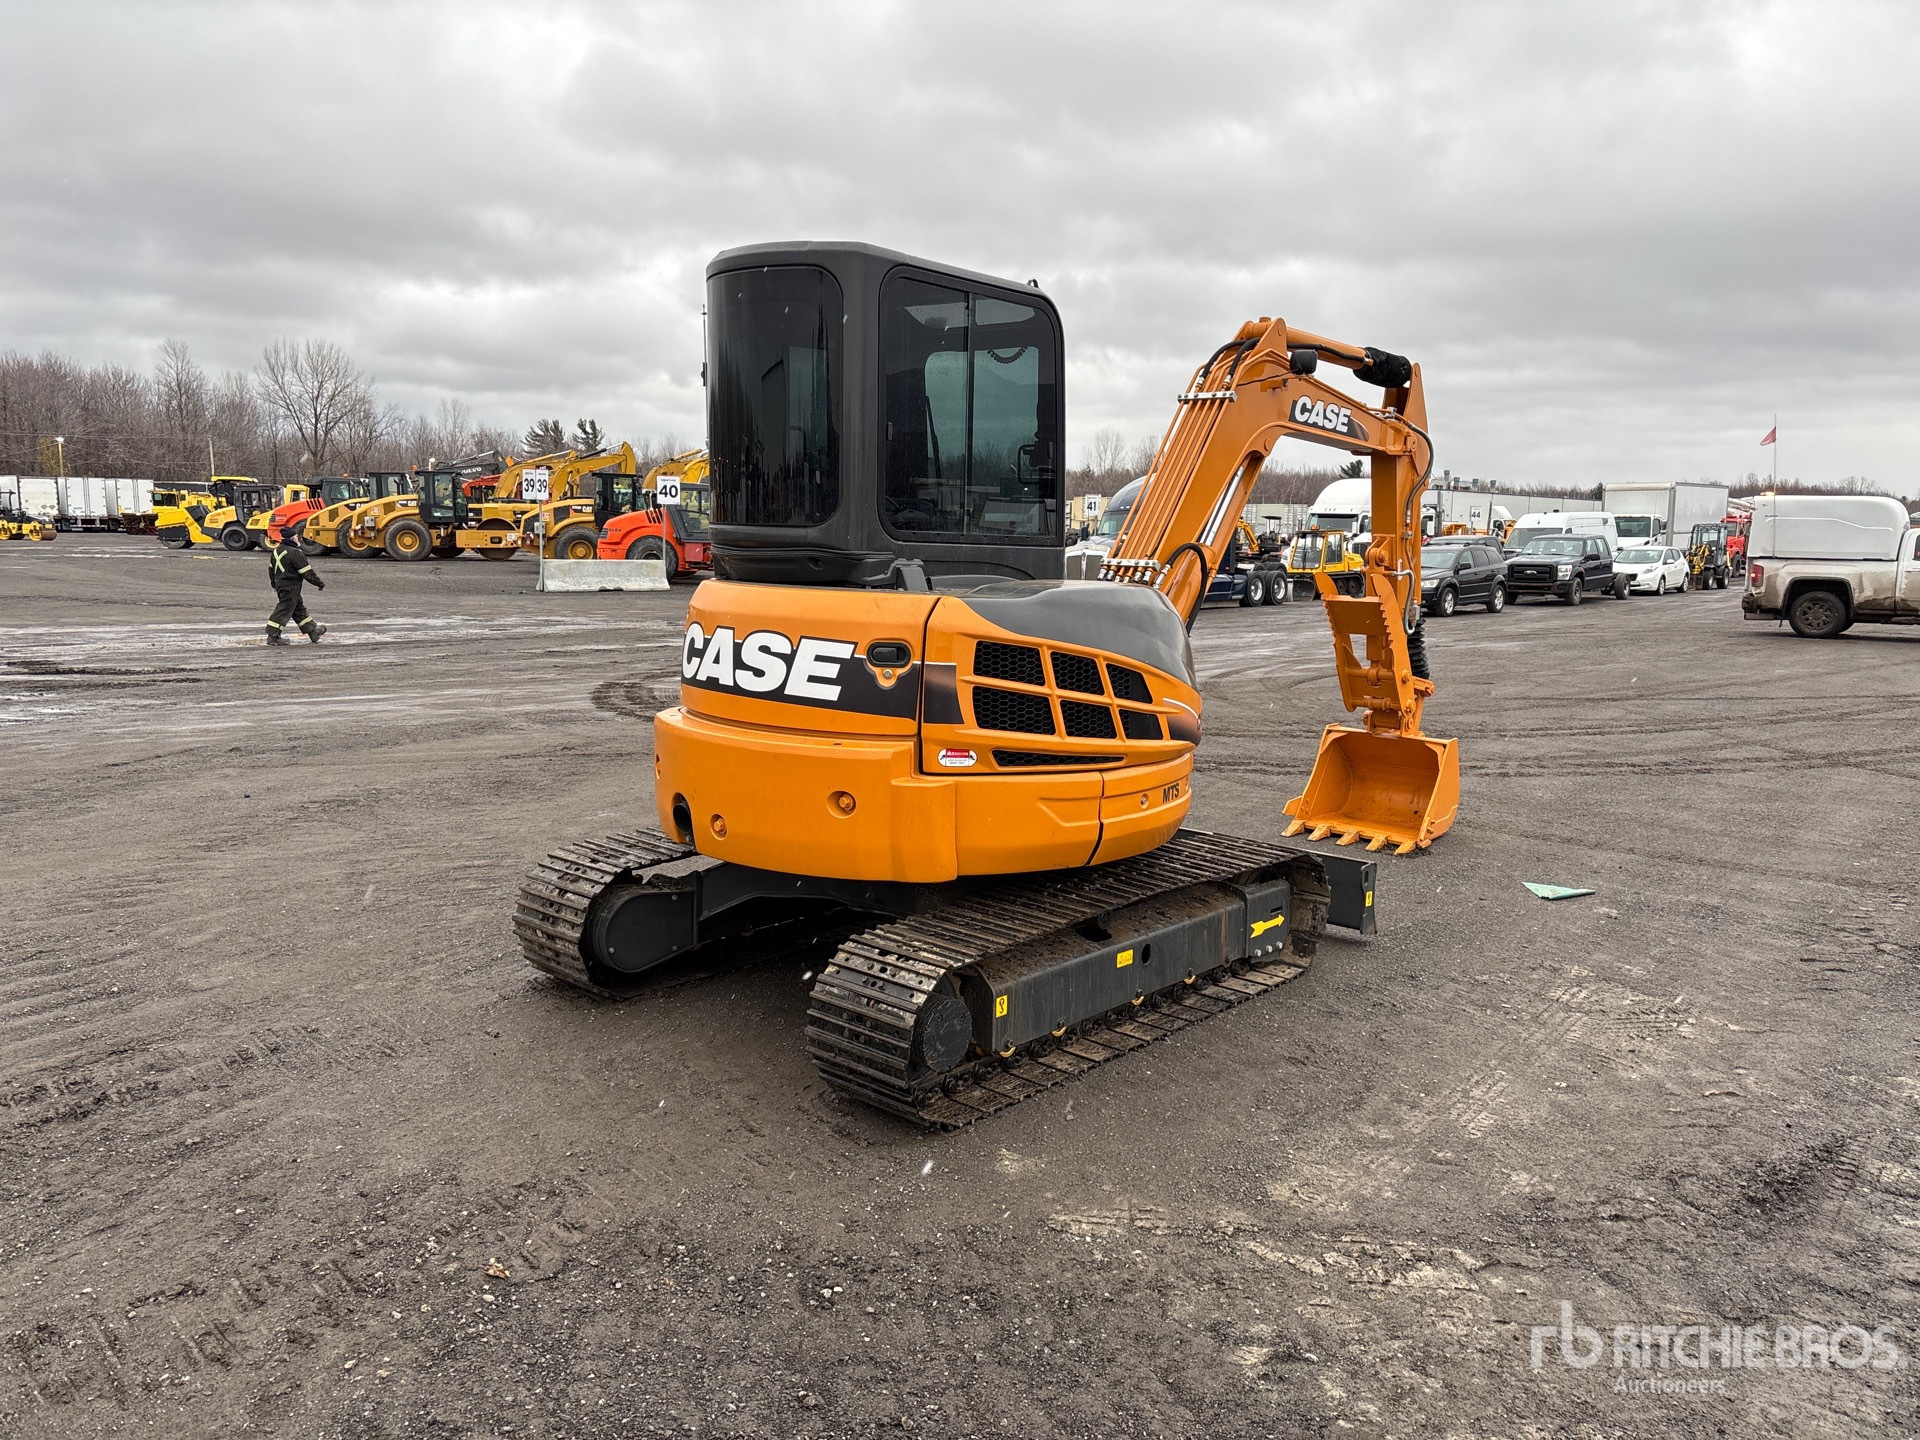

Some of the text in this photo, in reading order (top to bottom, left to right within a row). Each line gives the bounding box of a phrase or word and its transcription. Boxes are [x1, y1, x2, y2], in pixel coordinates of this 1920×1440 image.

[1294, 395, 1352, 433] CASE
[524, 478, 535, 492] 39
[537, 479, 547, 493] 39
[658, 484, 679, 498] 40
[1086, 501, 1097, 511] 41
[682, 622, 856, 701] CASE
[1163, 782, 1180, 803] MTS
